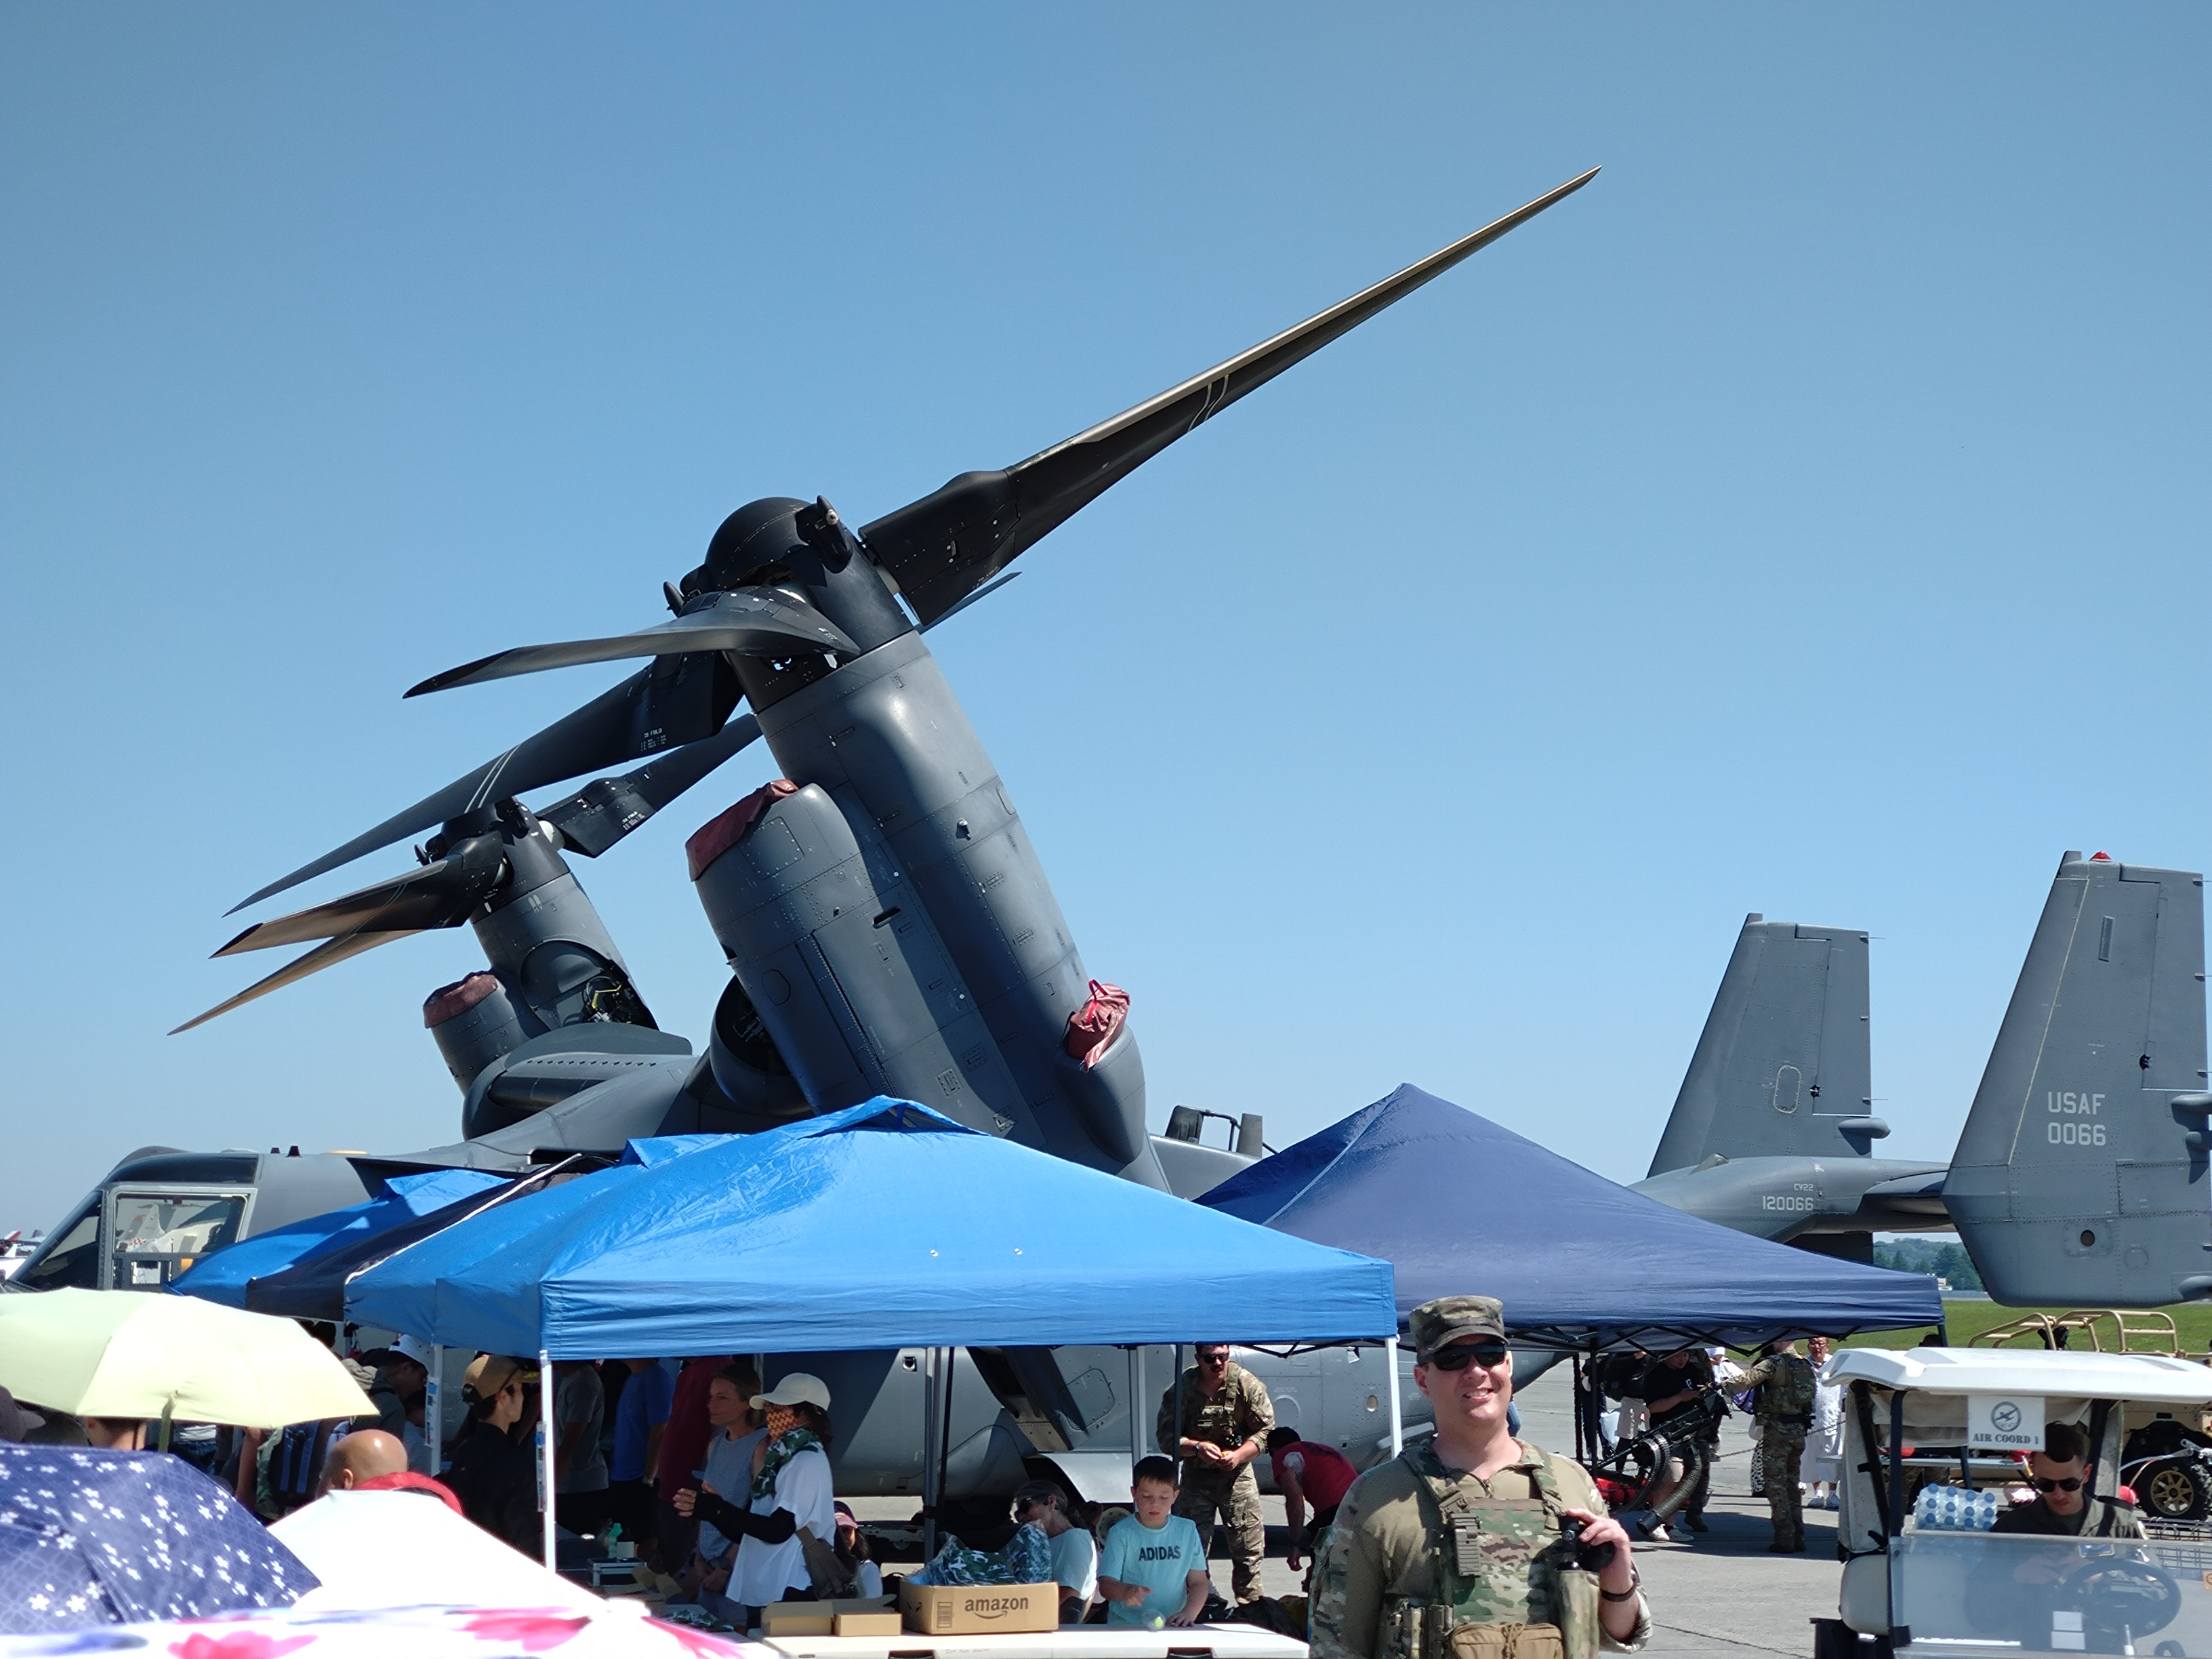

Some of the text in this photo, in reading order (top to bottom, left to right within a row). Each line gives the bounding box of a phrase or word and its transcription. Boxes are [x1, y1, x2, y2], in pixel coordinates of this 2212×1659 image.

[2048, 1091, 2106, 1115] USAF
[2048, 1122, 2106, 1146] 0066
[1794, 1183, 1814, 1191] CV22
[1763, 1195, 1814, 1211] 120066
[1973, 1433, 1992, 1442] AIR
[1994, 1433, 2031, 1444] COORD
[1139, 1546, 1181, 1561] ADIDAS
[964, 1597, 1029, 1612] amazon
